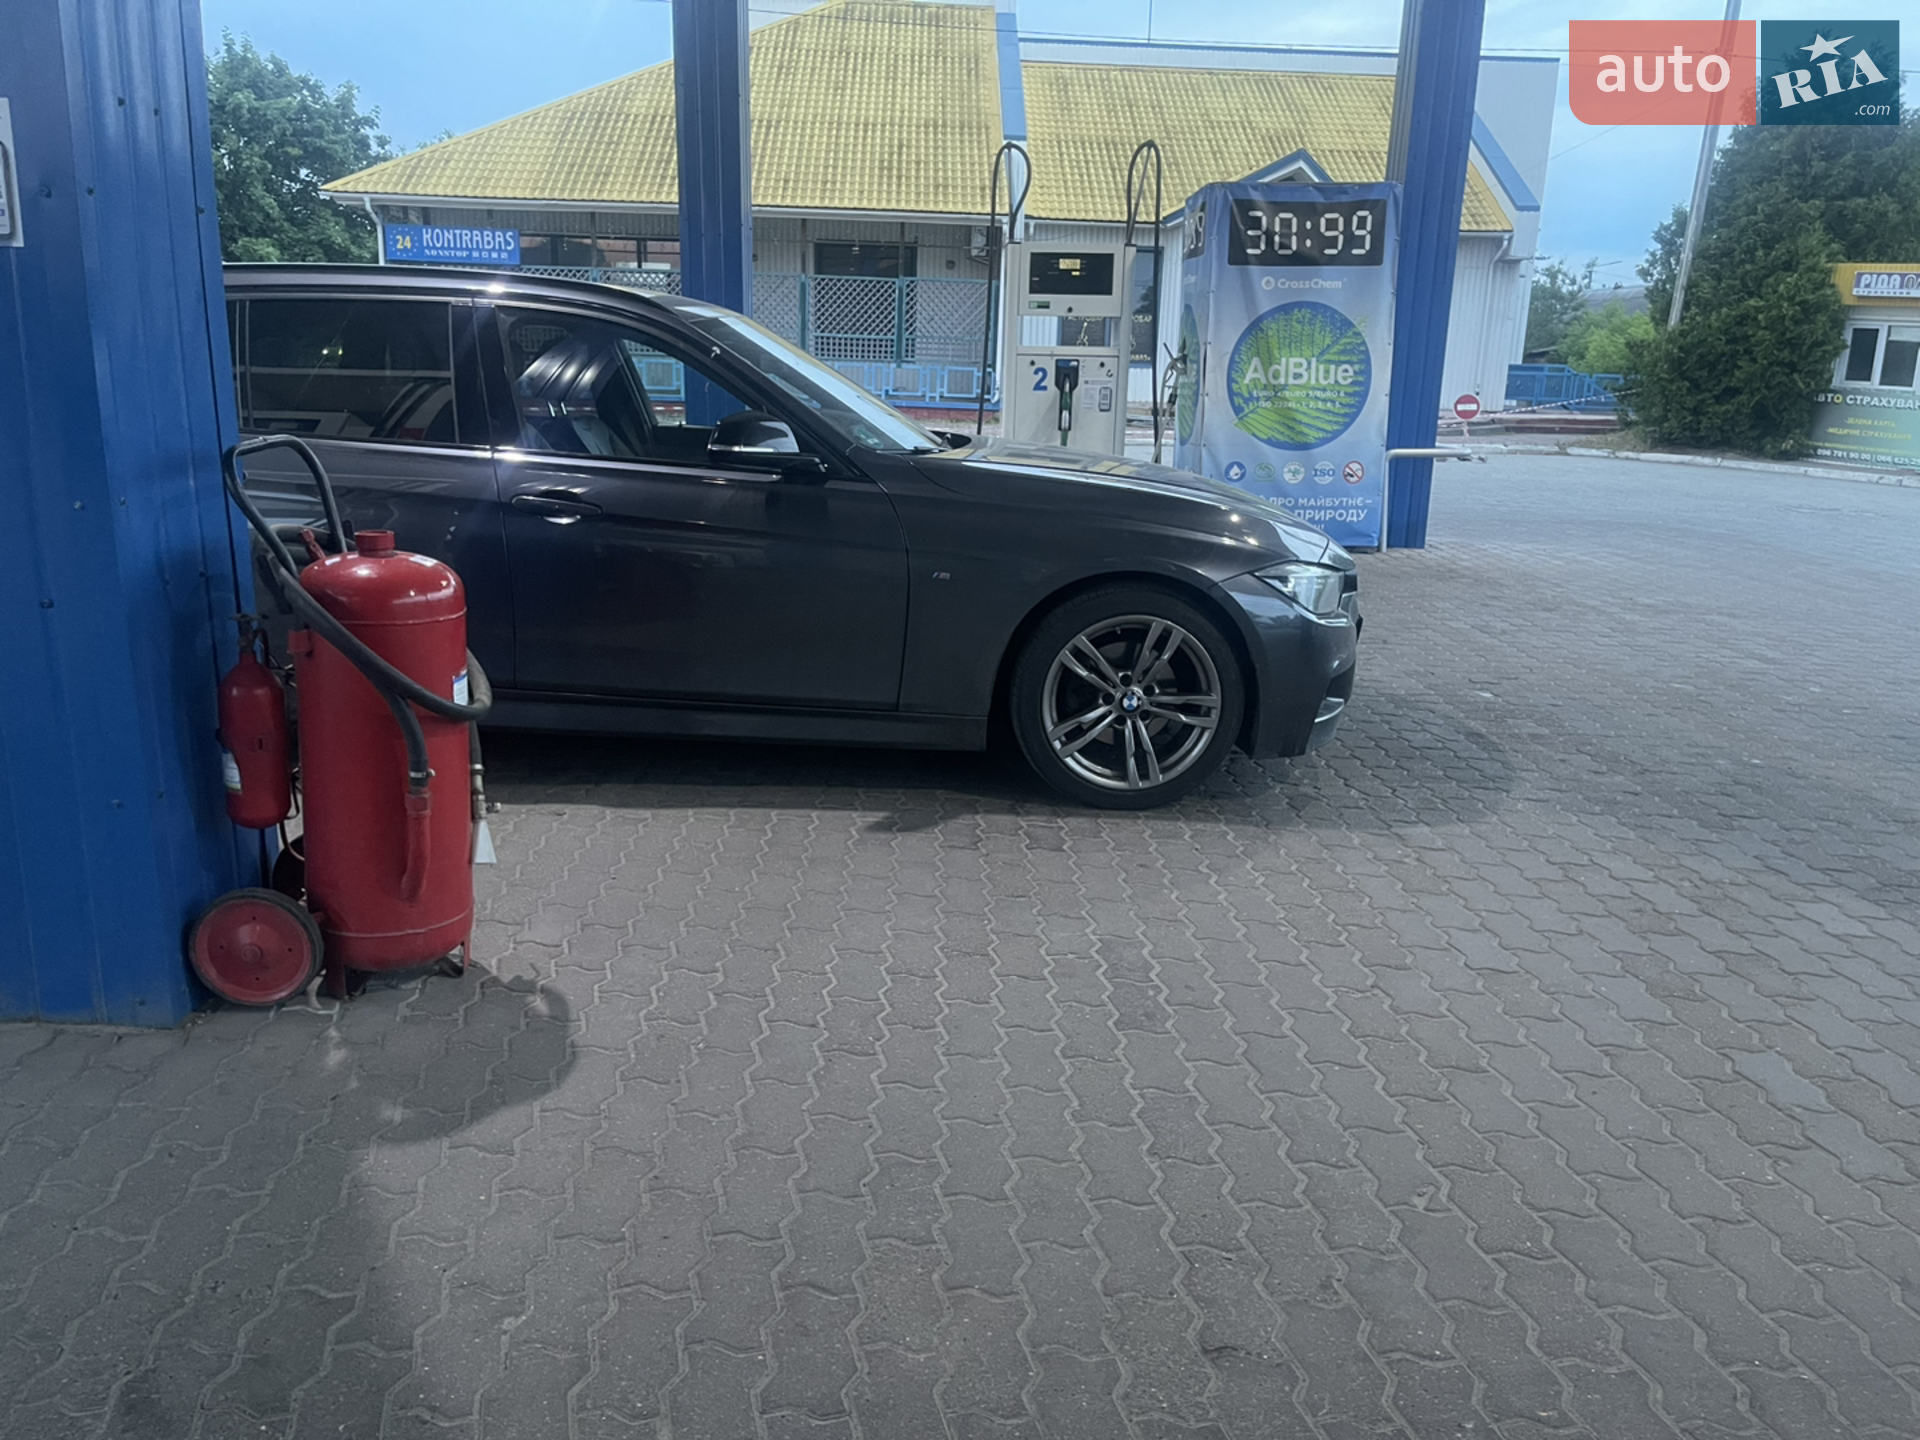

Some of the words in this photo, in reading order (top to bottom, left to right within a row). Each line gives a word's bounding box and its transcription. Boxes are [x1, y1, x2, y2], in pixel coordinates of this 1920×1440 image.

[396, 235, 412, 250] 24
[422, 228, 515, 250] KONTRABAS
[1246, 210, 1373, 255] 30:99
[424, 249, 470, 258] NONSTOP
[1277, 278, 1342, 289] CrossChem
[1033, 367, 1048, 391] 2
[1243, 357, 1355, 385] AdBlue
[1312, 468, 1335, 477] ISO
[1294, 509, 1368, 522] ПРИРОДУ
